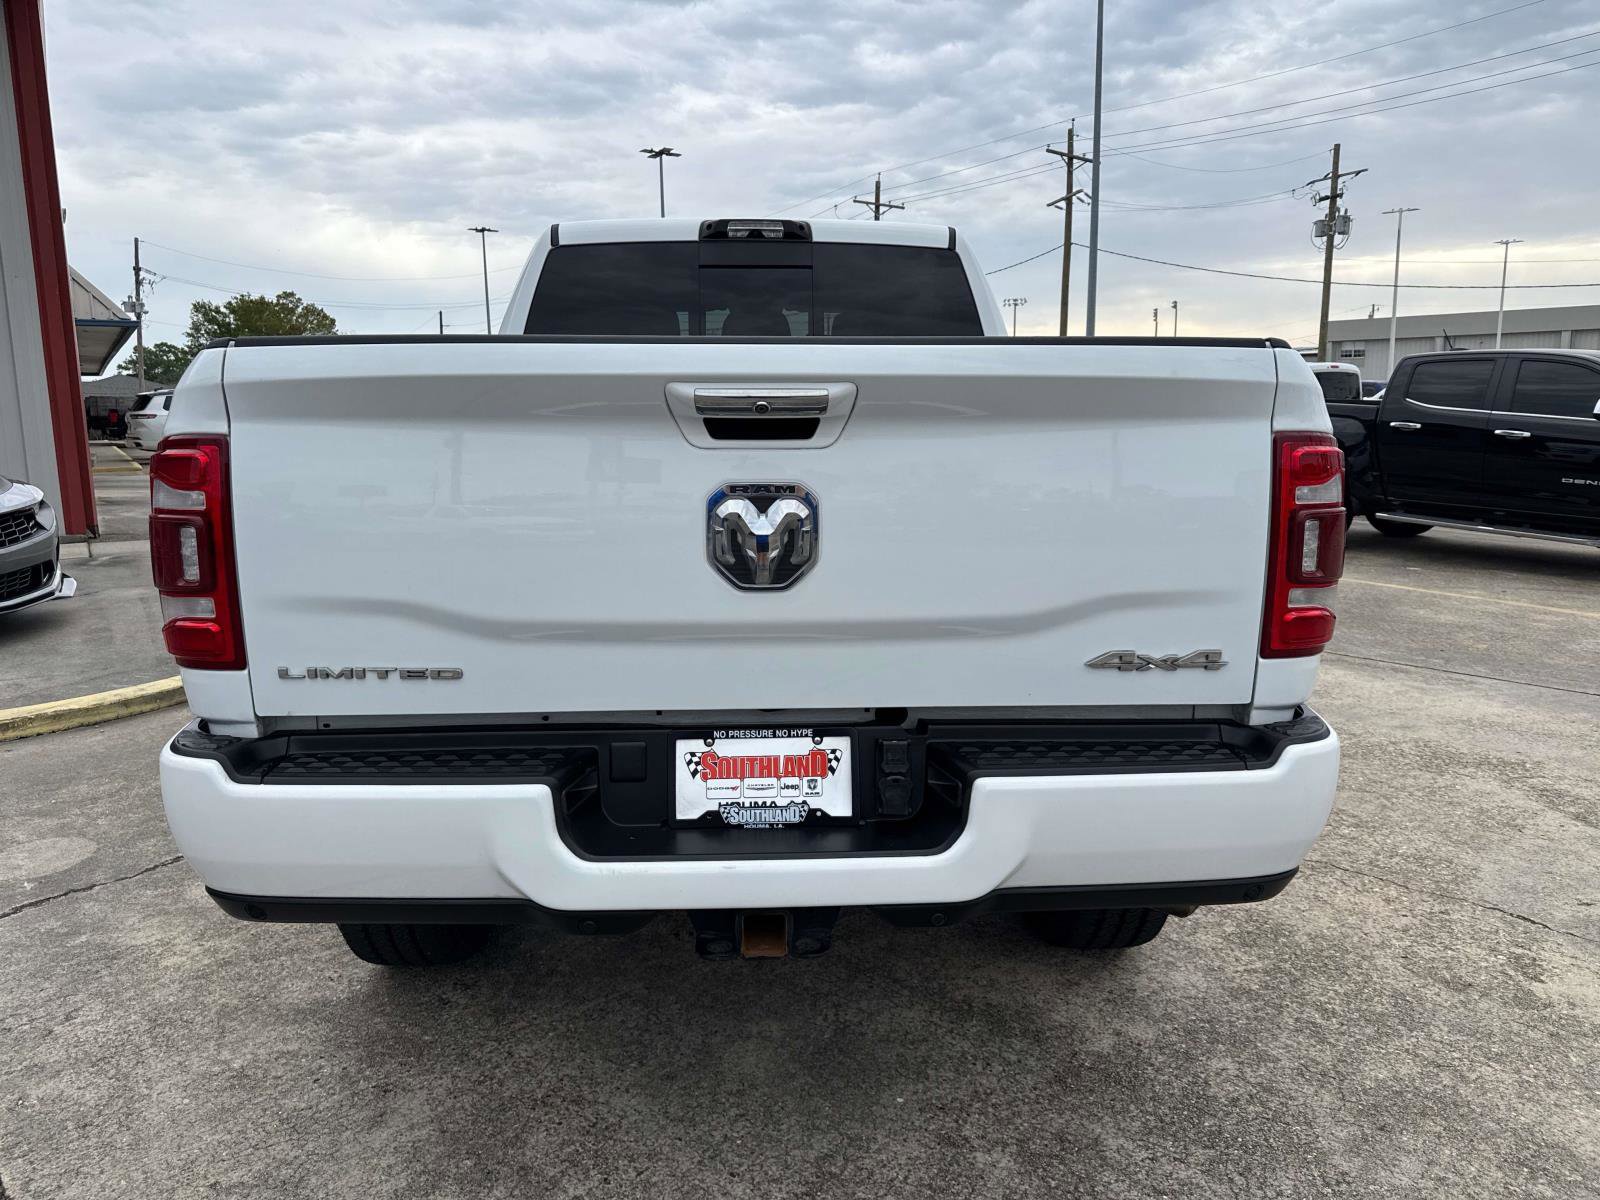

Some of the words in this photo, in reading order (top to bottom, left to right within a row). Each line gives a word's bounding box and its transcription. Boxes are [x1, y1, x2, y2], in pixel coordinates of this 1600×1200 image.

[1561, 477, 1600, 486] DEN
[729, 485, 796, 494] RAM
[277, 666, 464, 680] LIMITED
[713, 730, 727, 739] NO
[728, 729, 774, 738] PRESSURE
[775, 729, 789, 738] NO
[790, 728, 814, 737] HYPE
[701, 750, 828, 780] SOUTHLAND
[780, 782, 800, 791] Jeep
[729, 805, 800, 824] SOUTHLAND
